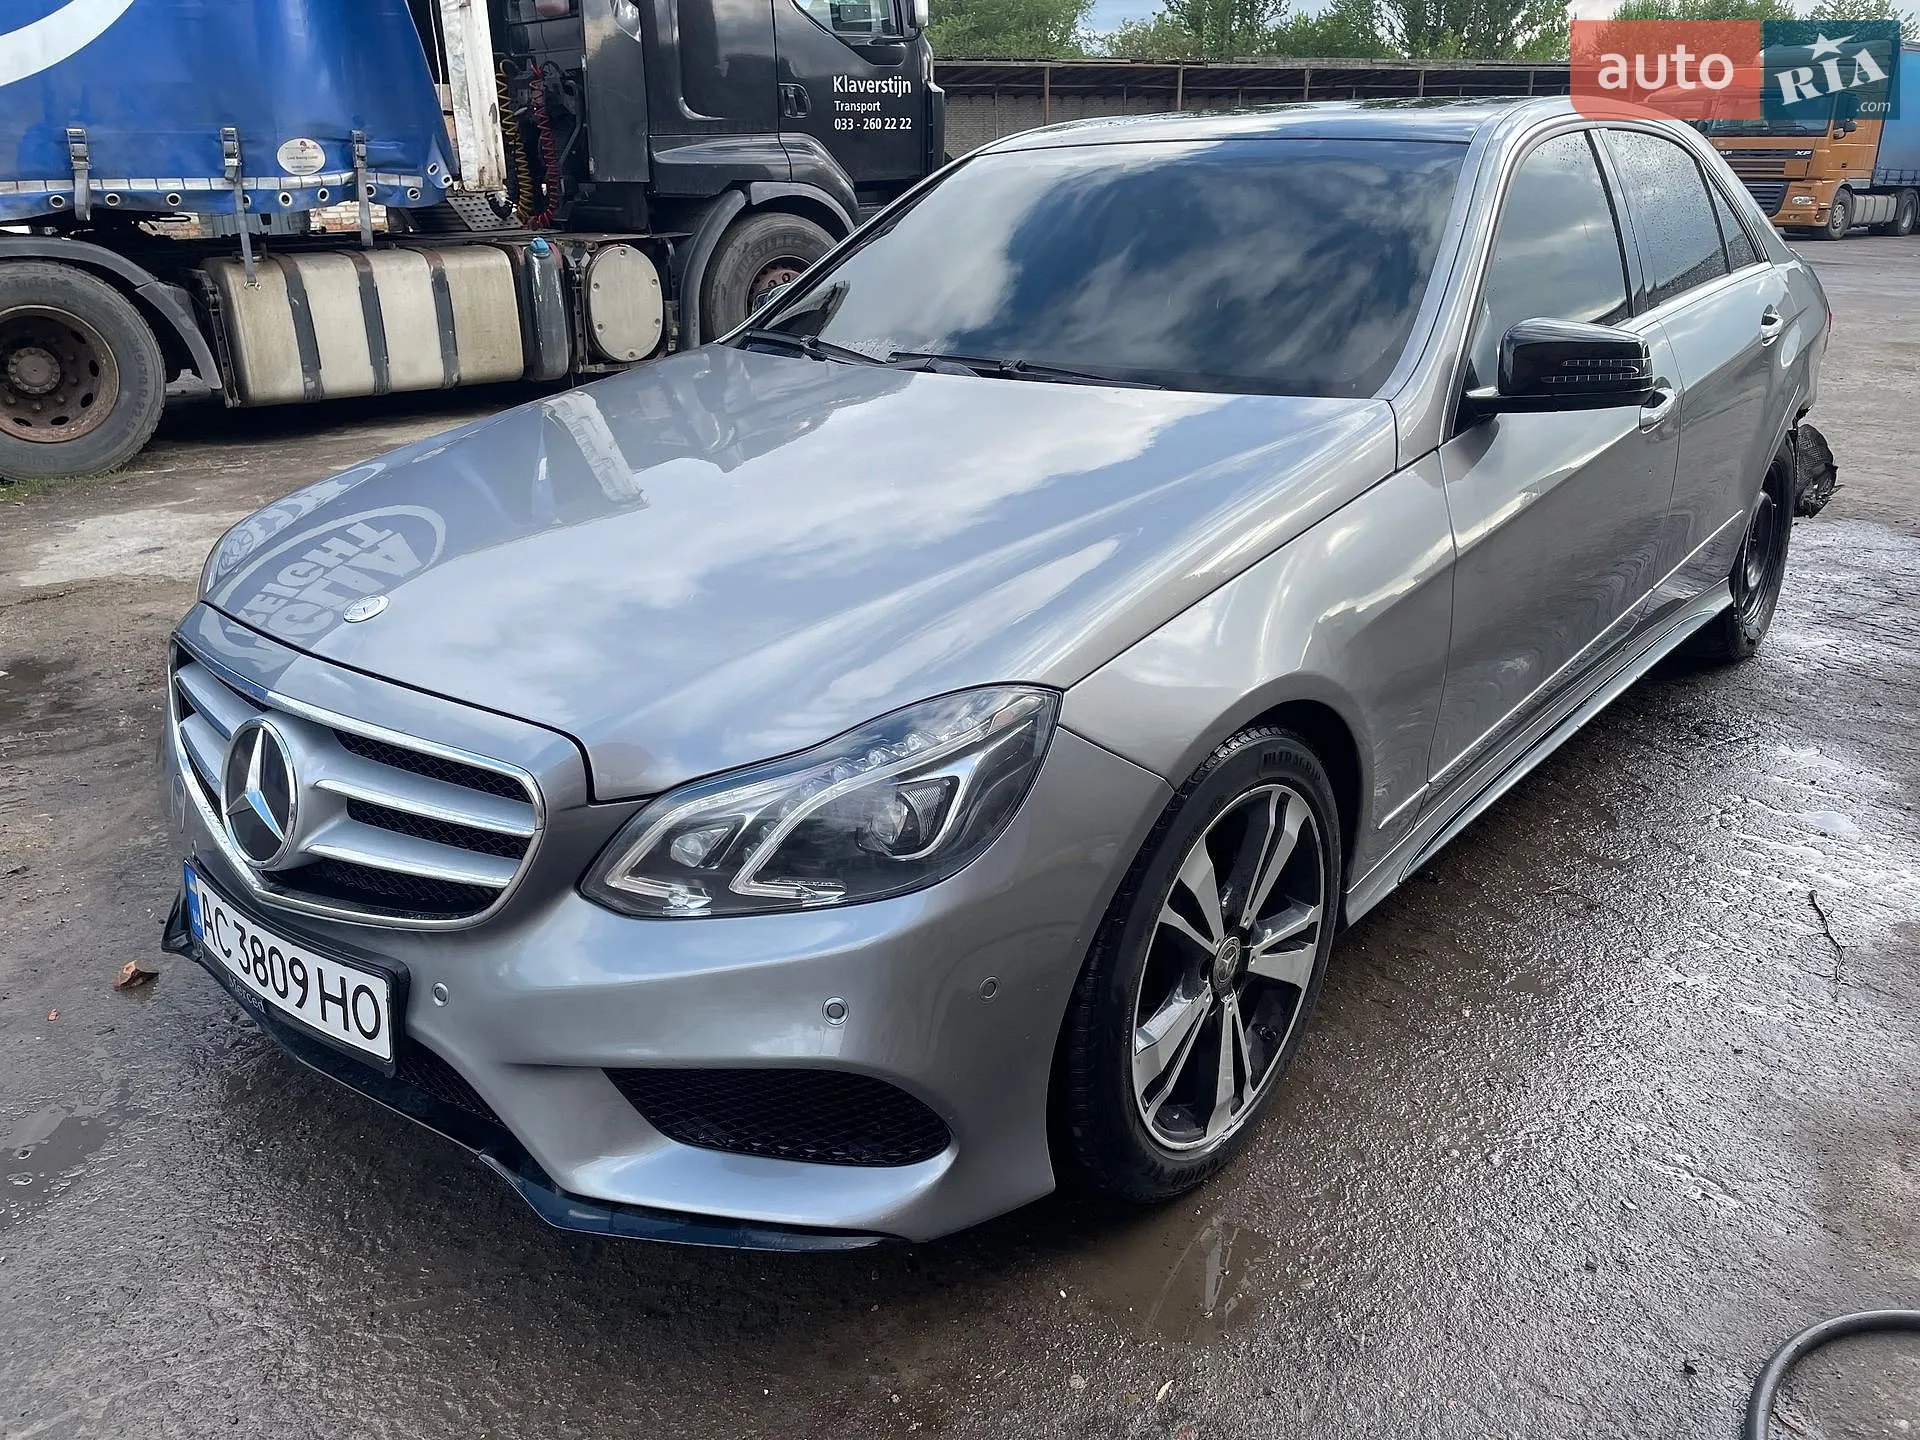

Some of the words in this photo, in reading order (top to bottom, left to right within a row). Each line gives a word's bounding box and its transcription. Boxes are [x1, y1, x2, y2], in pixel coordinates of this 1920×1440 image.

[833, 75, 912, 98] Klaverstijn
[834, 100, 881, 114] Transport
[834, 118, 854, 130] 033
[863, 117, 881, 130] 260
[884, 118, 897, 130] 22
[899, 118, 912, 130] 22
[201, 891, 232, 959] AC
[232, 919, 309, 1010] 3809
[316, 966, 381, 1041] HO
